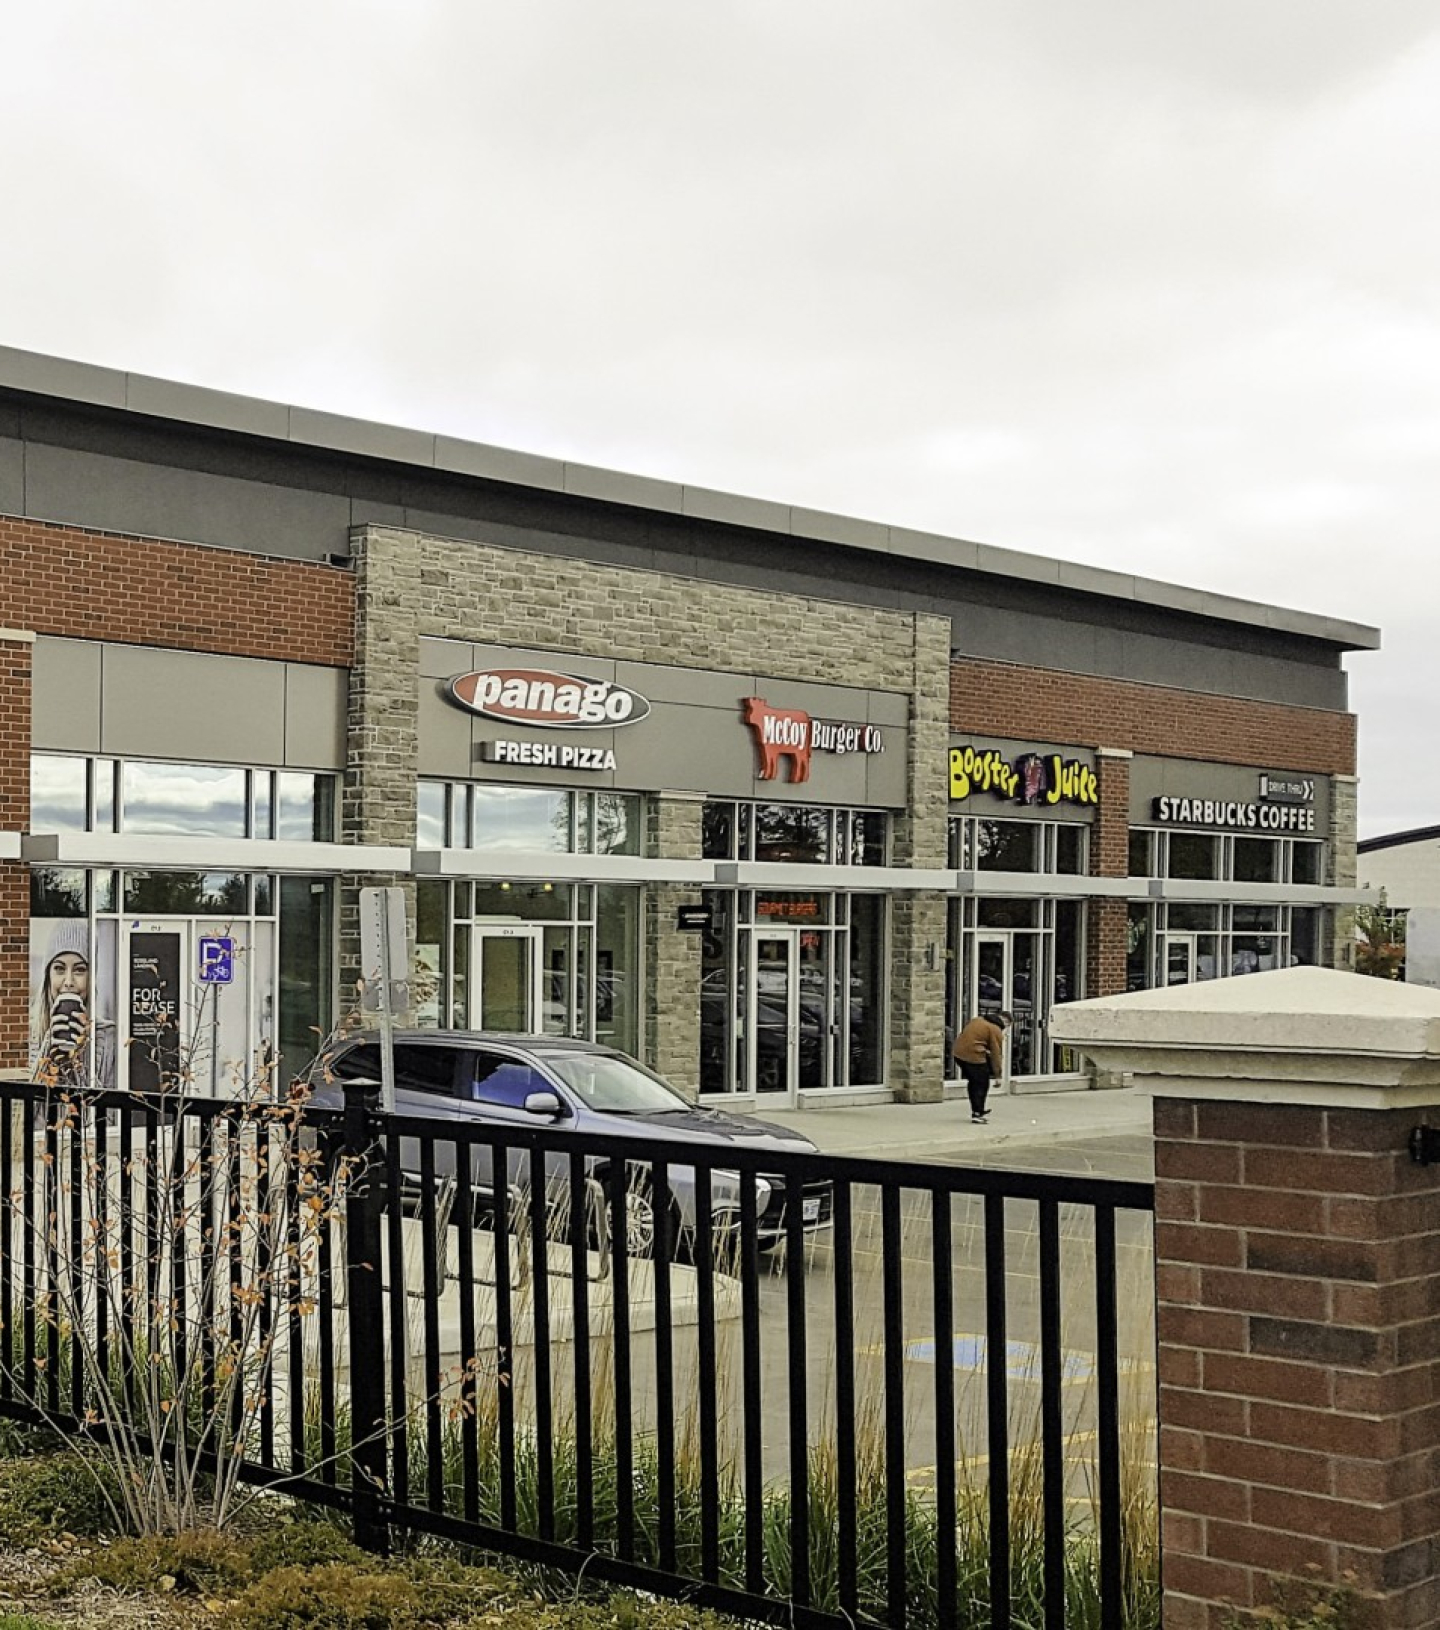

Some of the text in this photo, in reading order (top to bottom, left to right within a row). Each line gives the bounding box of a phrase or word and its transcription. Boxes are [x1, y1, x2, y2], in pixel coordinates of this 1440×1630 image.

[473, 674, 633, 723] panago
[763, 715, 885, 754] McCoy Burger Co.
[494, 741, 617, 771] FRESH PIZZA
[950, 747, 1098, 804] Booster Juice
[1268, 781, 1304, 795] DRIVE THRU
[1160, 796, 1315, 831] STARBUCKS COFFEE
[202, 941, 224, 978] P
[133, 987, 161, 1002] FOR
